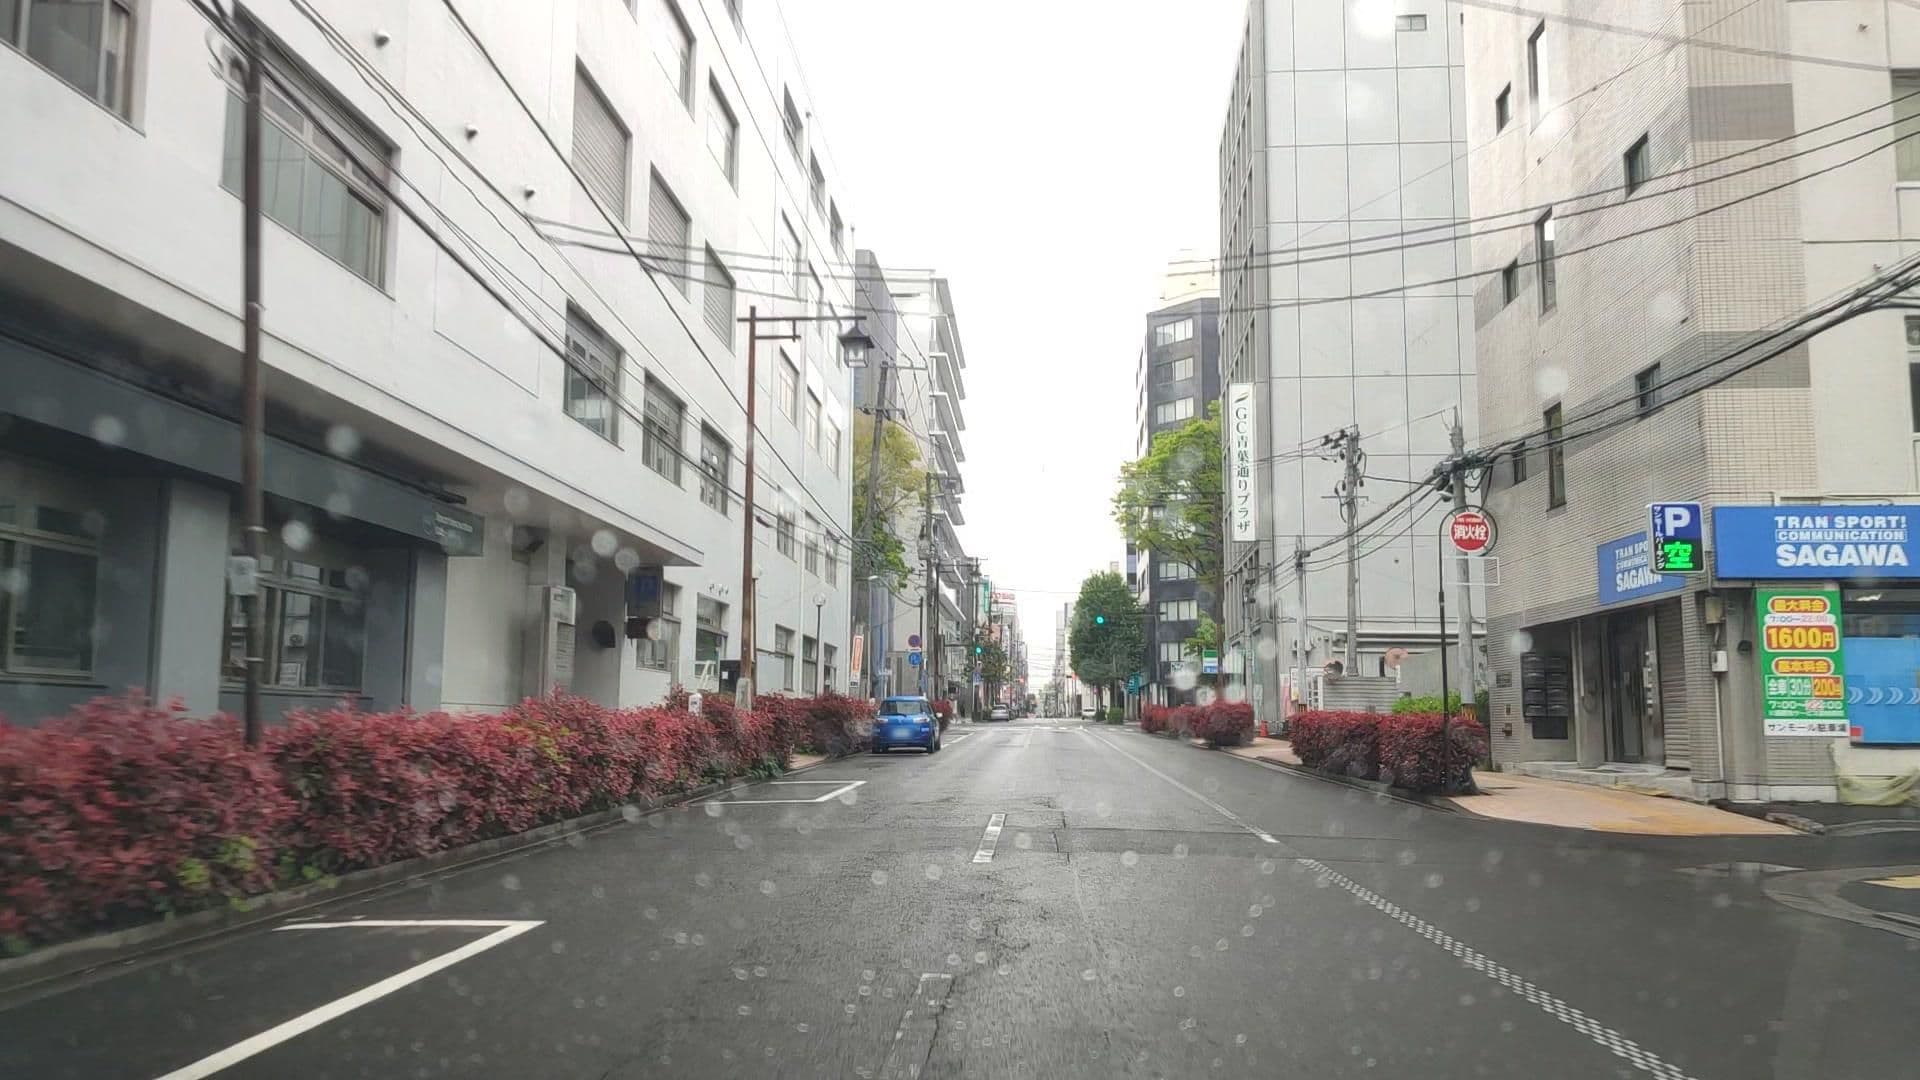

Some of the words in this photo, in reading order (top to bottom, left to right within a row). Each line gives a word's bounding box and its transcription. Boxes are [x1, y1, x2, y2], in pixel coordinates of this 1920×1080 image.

[1453, 524, 1487, 540] 消火栓
[1664, 507, 1691, 537] P
[1774, 515, 1829, 529] TRAN
[1833, 515, 1907, 529] SPORT!
[1778, 530, 1905, 541] COMMUNICATION
[1664, 541, 1693, 568] 空
[1776, 544, 1908, 567] SAGAWA
[1767, 627, 1835, 649] 1600円
